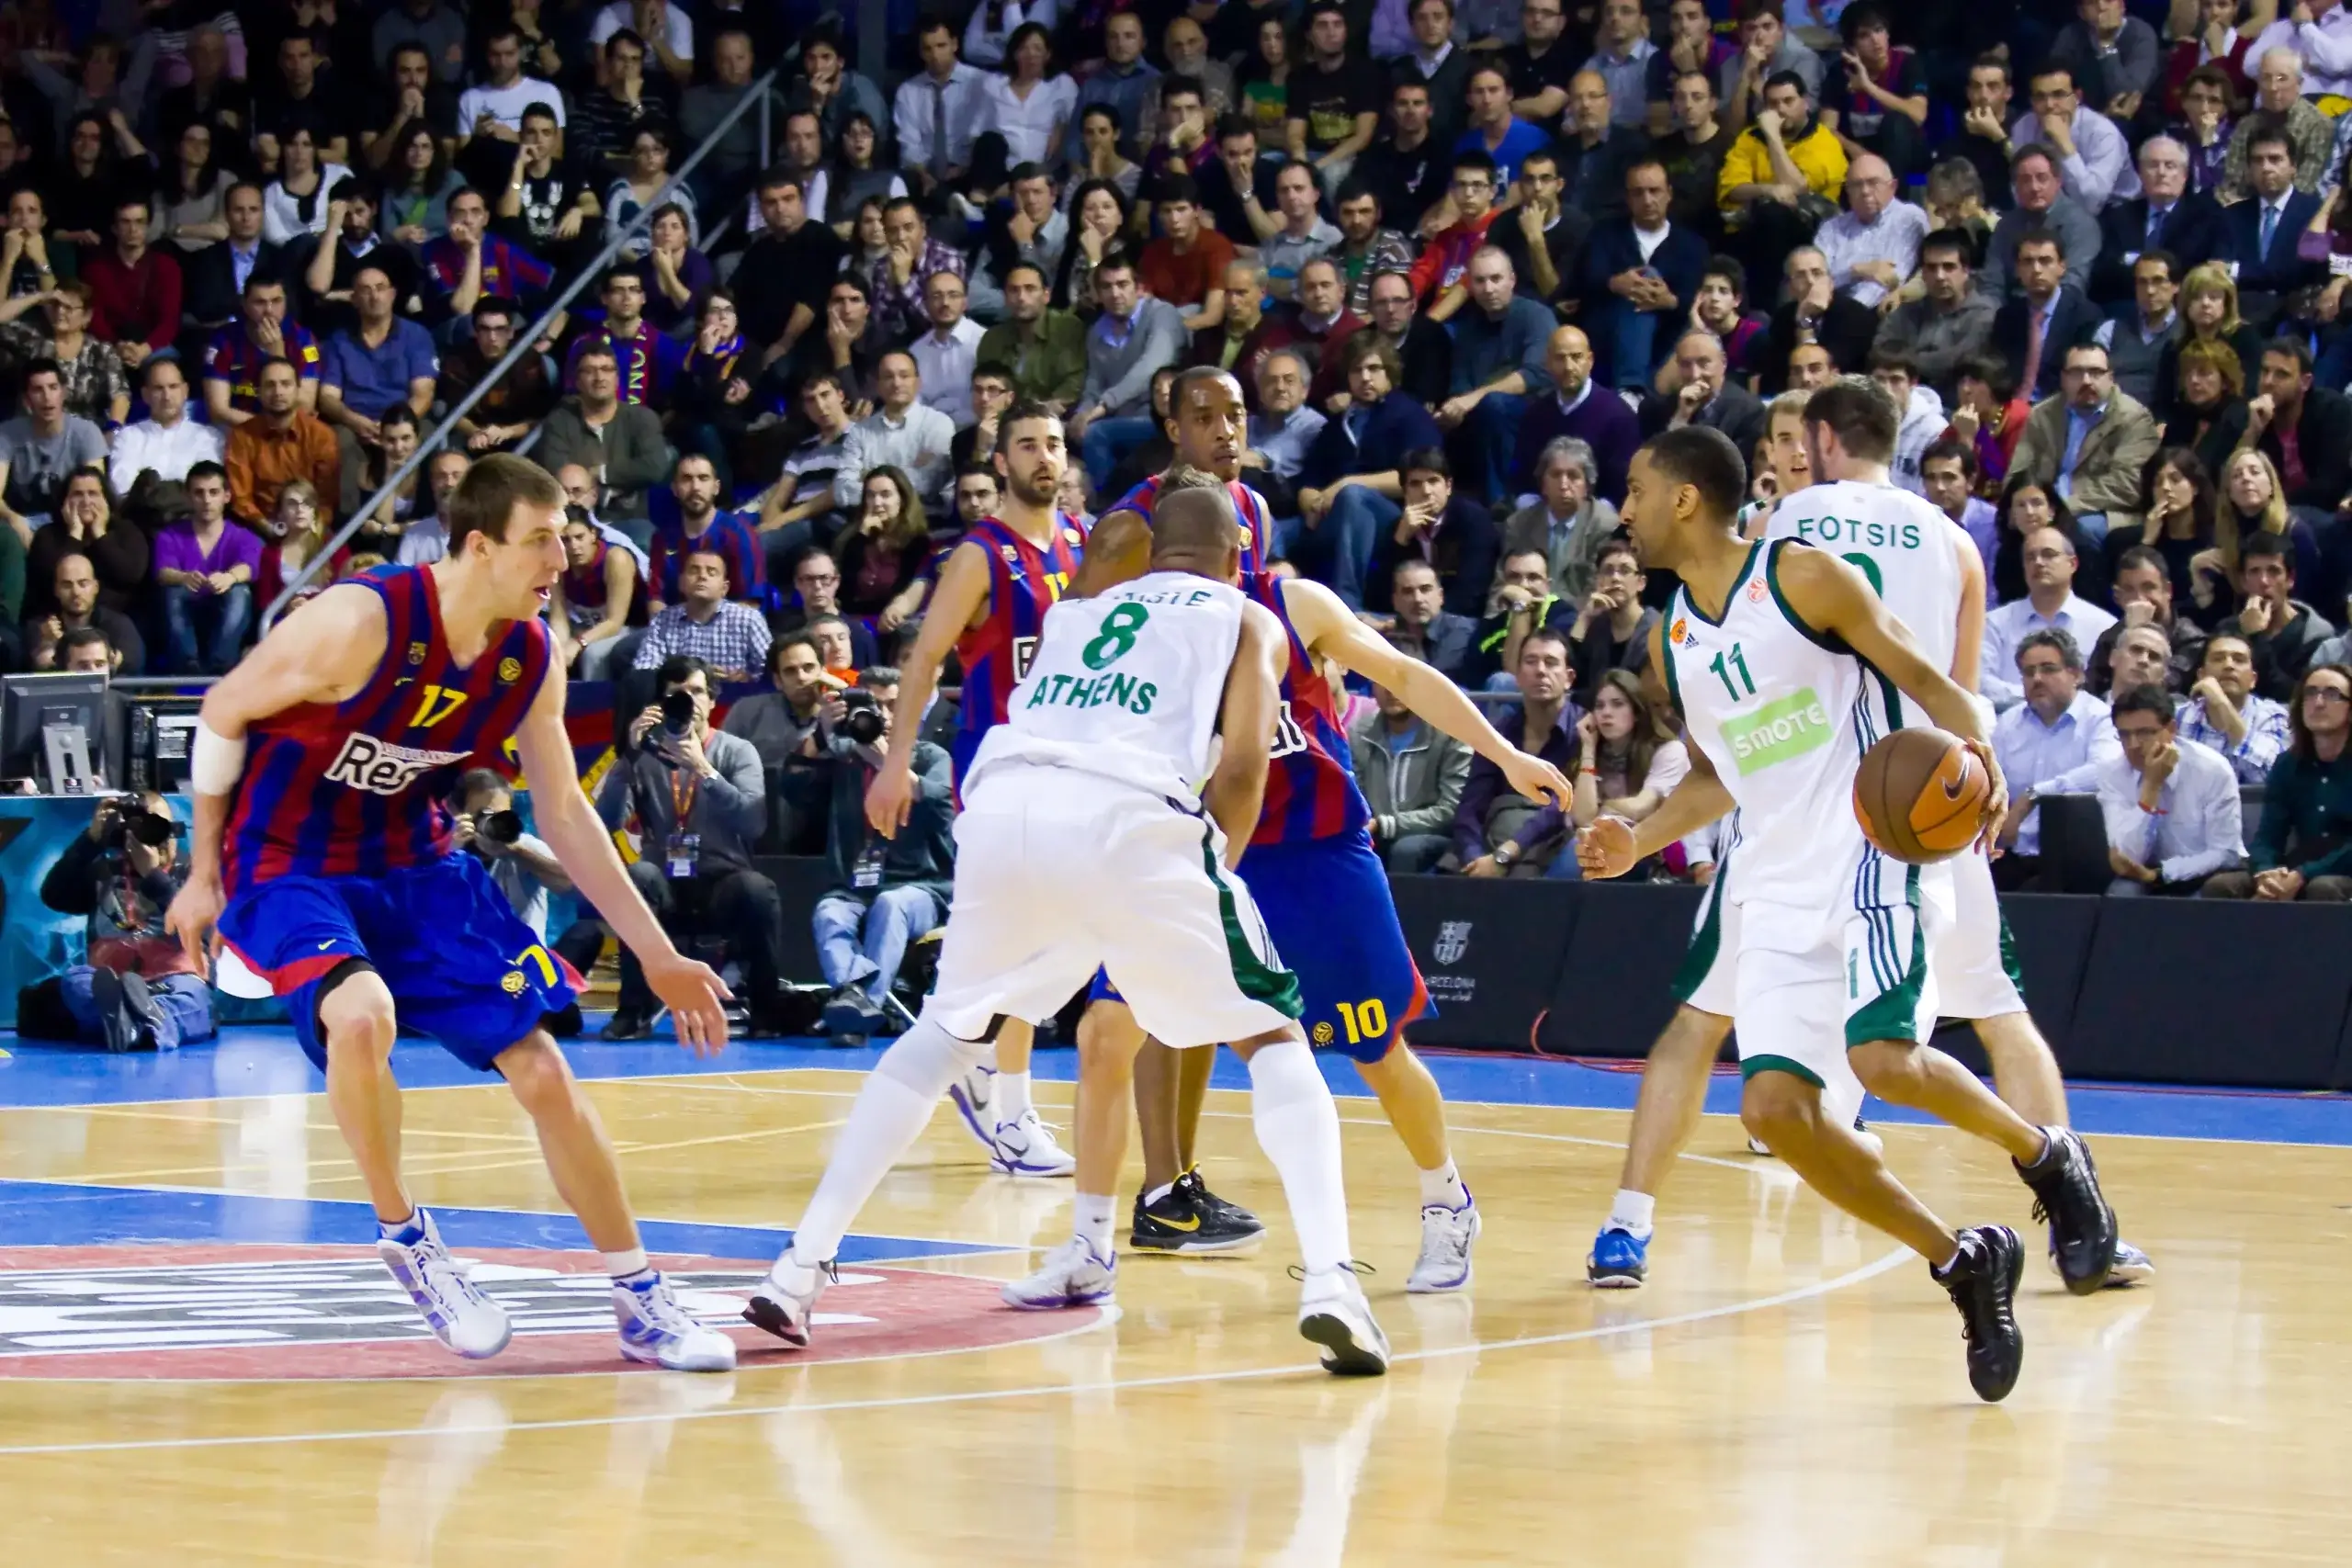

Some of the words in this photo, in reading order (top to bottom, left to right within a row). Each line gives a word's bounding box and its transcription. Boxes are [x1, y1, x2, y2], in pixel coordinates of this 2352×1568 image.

[1797, 515, 1921, 549] FOTSIS
[1081, 602, 1150, 671] 8
[1026, 671, 1158, 715] ATHENS
[1709, 641, 1757, 703] 11
[407, 684, 469, 728] 17
[1336, 998, 1388, 1044] 10
